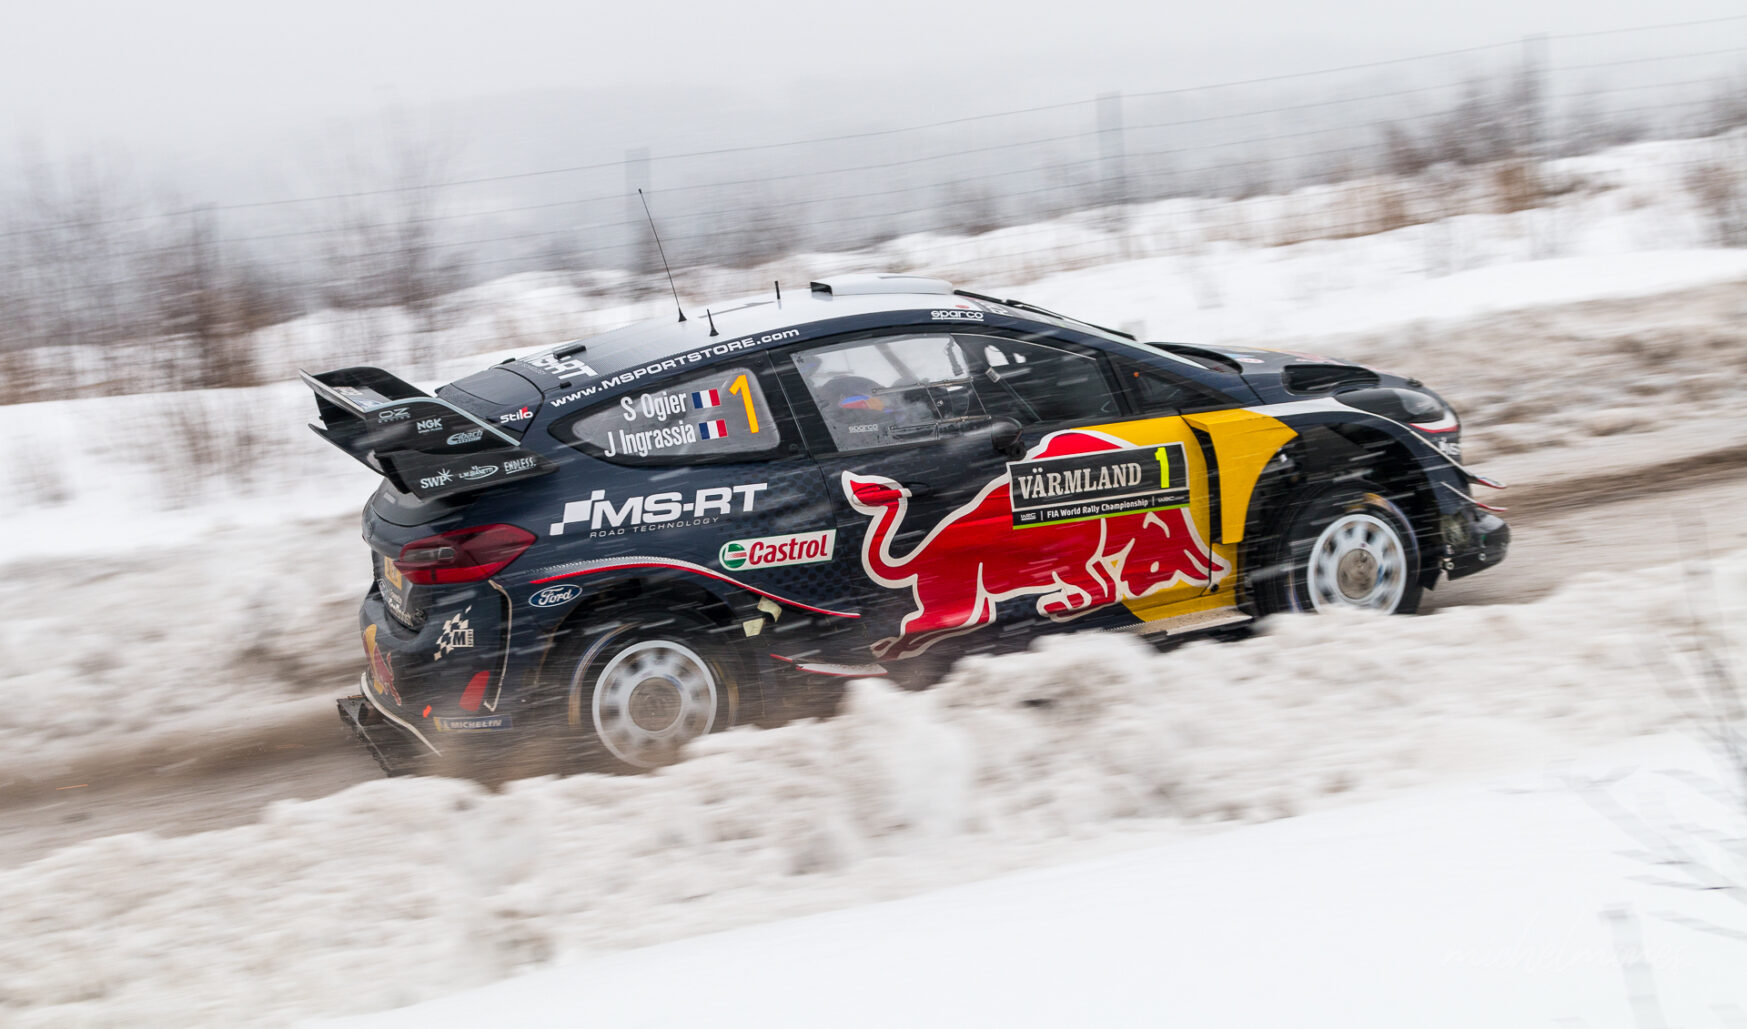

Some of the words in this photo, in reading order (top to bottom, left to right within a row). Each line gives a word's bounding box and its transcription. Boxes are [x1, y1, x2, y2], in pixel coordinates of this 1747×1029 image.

[931, 309, 984, 320] sparco
[551, 328, 800, 408] www.MSPORTSTORE.com
[379, 407, 410, 419] OZ
[620, 396, 637, 422] S
[640, 391, 688, 422] Ogier
[729, 374, 759, 433] 1
[416, 418, 443, 430] NGK
[604, 430, 616, 457] J
[619, 421, 697, 457] Ingrassia
[1154, 447, 1170, 488] 1
[420, 474, 448, 489] SWP
[1018, 462, 1142, 500] VÄRMLAND
[590, 483, 767, 530] MS-RT
[1047, 510, 1059, 518] FIA
[1061, 507, 1080, 517] World
[1082, 505, 1100, 514] Rally
[1101, 498, 1149, 511] Championship
[590, 528, 626, 538] ROAD
[633, 516, 720, 534] TECHNOLOGY
[748, 534, 828, 565] Castrol
[538, 586, 573, 606] Ford
[450, 719, 502, 729] MICHELIN
